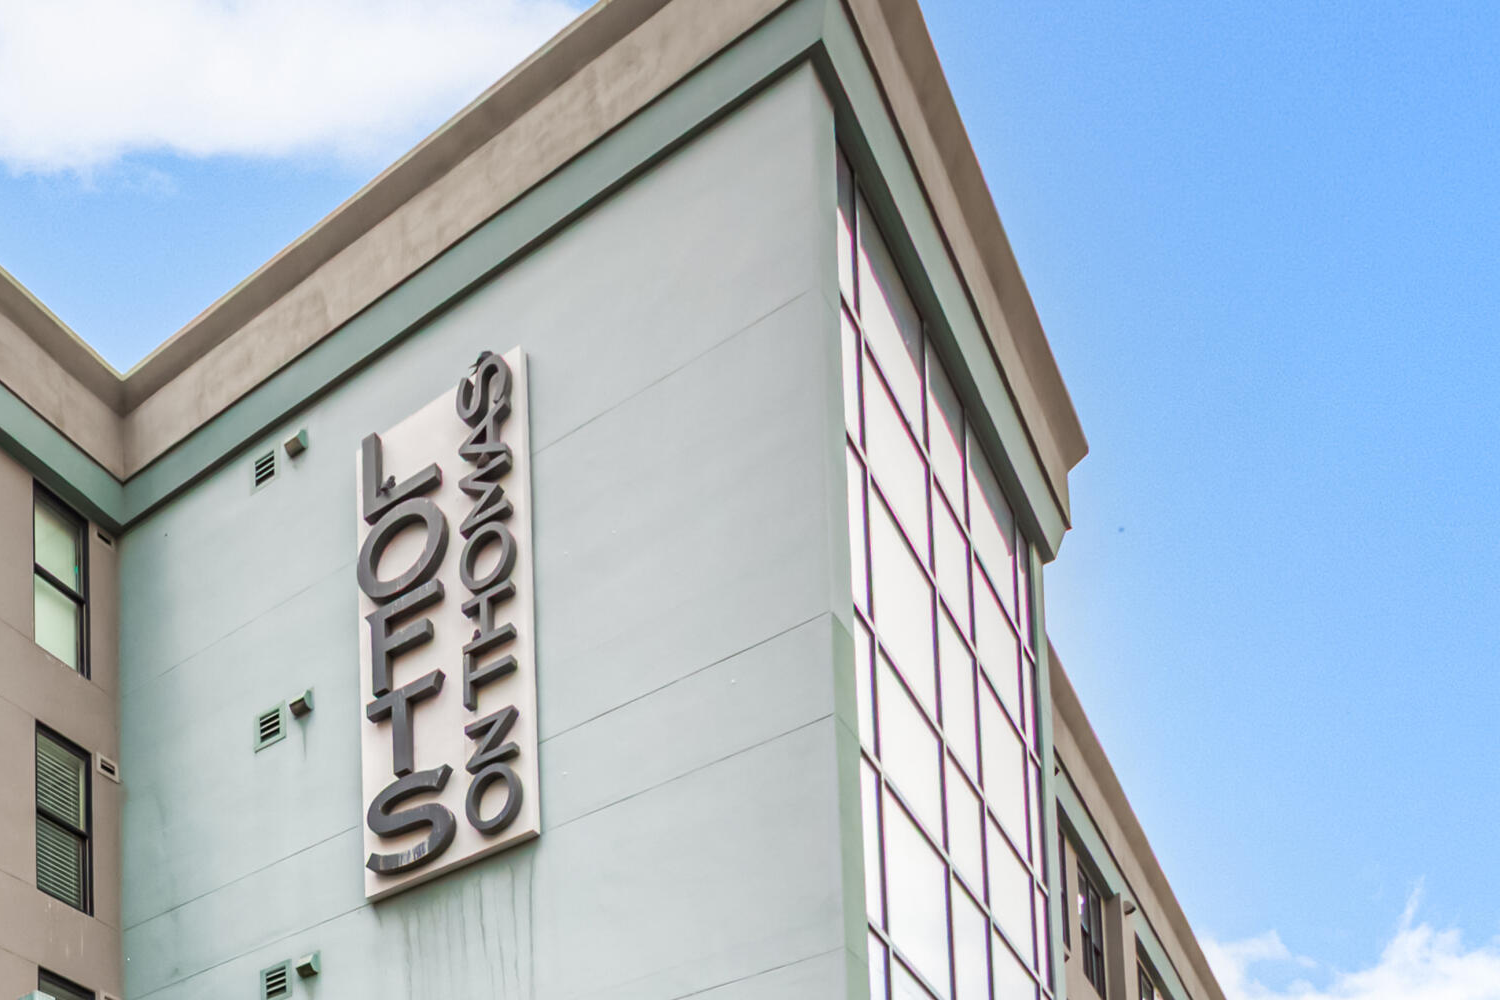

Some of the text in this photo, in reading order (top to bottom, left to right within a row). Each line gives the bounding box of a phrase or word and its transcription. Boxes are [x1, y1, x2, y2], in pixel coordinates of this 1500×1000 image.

[356, 432, 457, 877] LOFTS
[455, 351, 524, 836] ON THOMAS
